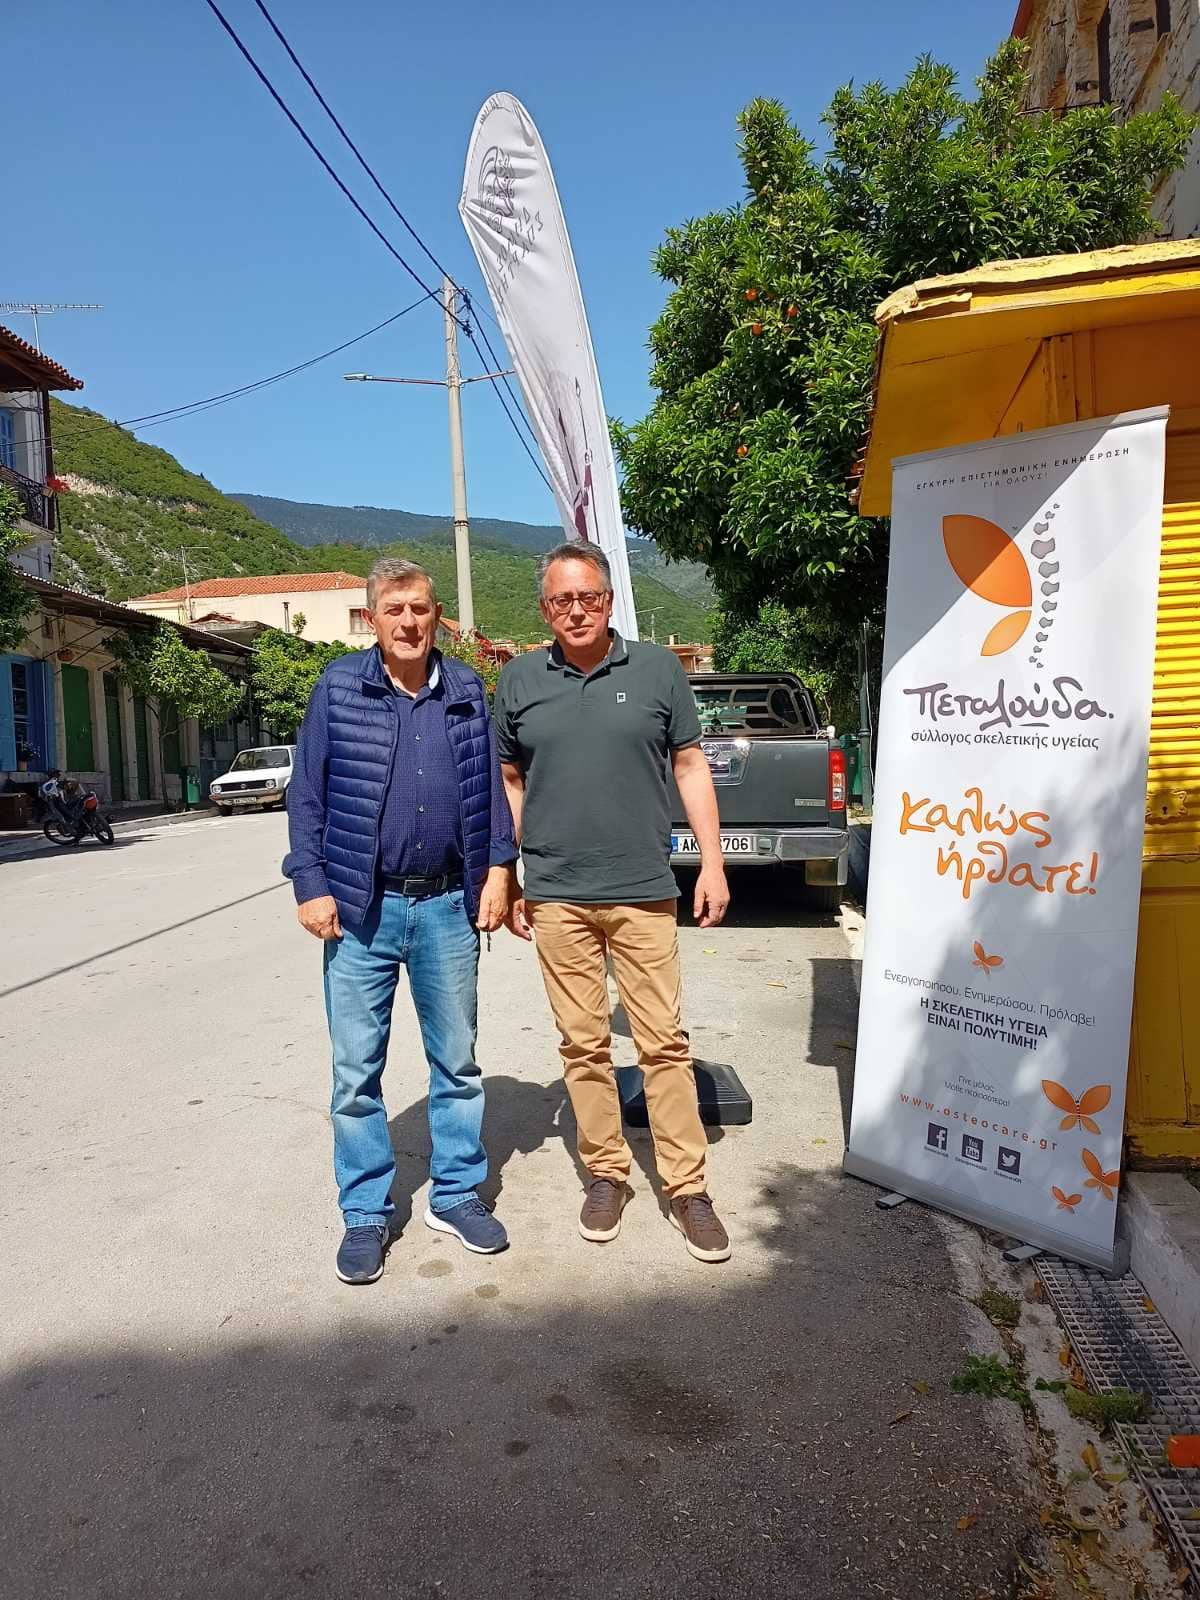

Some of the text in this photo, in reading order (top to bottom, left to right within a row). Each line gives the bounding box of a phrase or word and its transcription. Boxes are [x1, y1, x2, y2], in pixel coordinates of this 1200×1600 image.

[961, 462, 1047, 482] ΕΠΙΣΤΗΜΟΝΙΚΗ
[1054, 447, 1129, 467] ΕΝΗΜΕΡΩΣΗ
[911, 729, 1100, 750] σύλλογος σκελετικής υγείας
[899, 787, 1051, 848] Καλώς
[936, 841, 1098, 899] ήρθατε!
[920, 997, 1048, 1038] Η ΣΚΕΛΕΤΙΚΗ ΥΓΕΙΑ
[927, 1013, 1037, 1051] ΕΙΝΑΙ ΠΟΛΥΤΙΜΗ!
[1040, 1004, 1096, 1027] Πρόλαβε!
